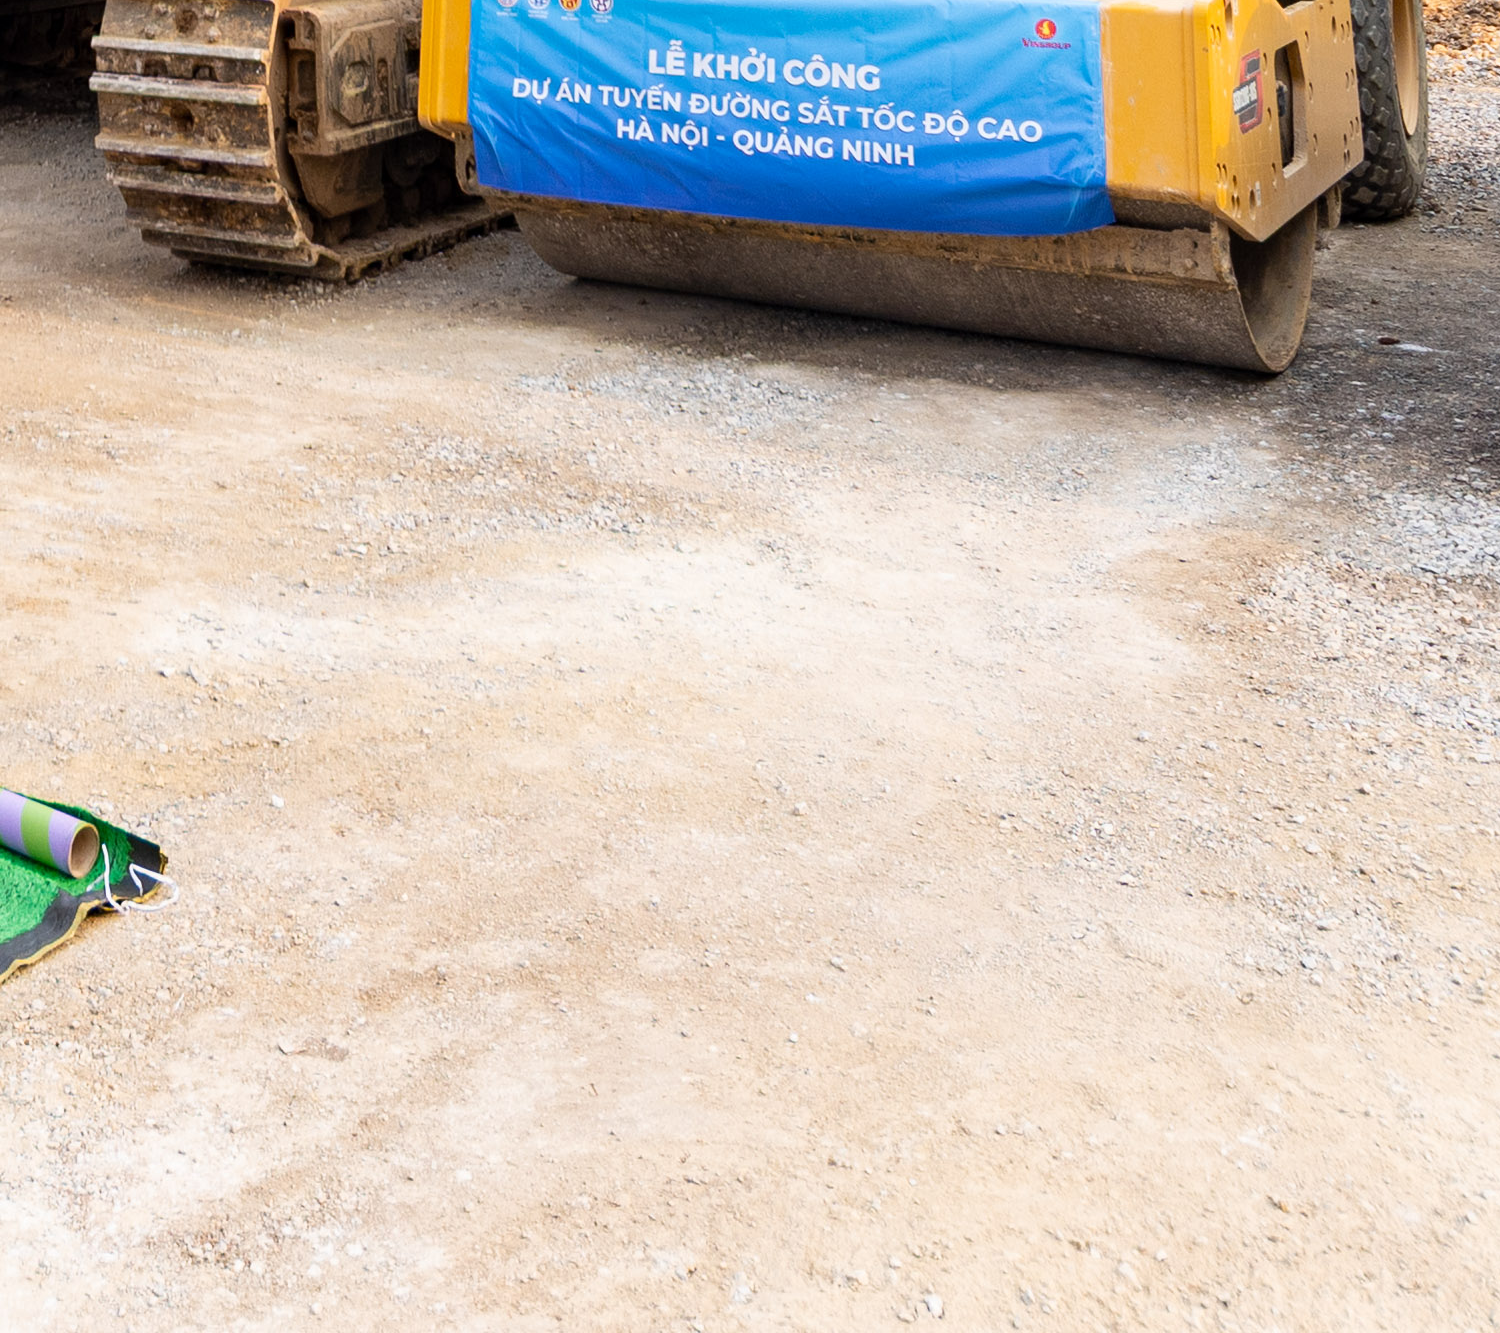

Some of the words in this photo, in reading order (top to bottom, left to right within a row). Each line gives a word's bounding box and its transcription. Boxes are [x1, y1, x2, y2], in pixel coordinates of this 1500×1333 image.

[648, 40, 687, 76] LỄ
[693, 47, 776, 84] KHỞI
[782, 54, 881, 92] CÔNG
[512, 77, 550, 107] DỰ
[555, 76, 592, 104] ÁN
[598, 84, 683, 112] TUYẾN
[688, 90, 791, 122] ĐƯỜNG
[798, 95, 852, 126] SẮT
[856, 101, 917, 133] TỐC
[922, 109, 970, 141] ĐỘ
[977, 117, 1043, 143] CAO
[616, 116, 654, 144] HÀ
[661, 119, 710, 151] NỘI
[733, 126, 834, 160] QUẢNG
[841, 139, 915, 168] NINH
